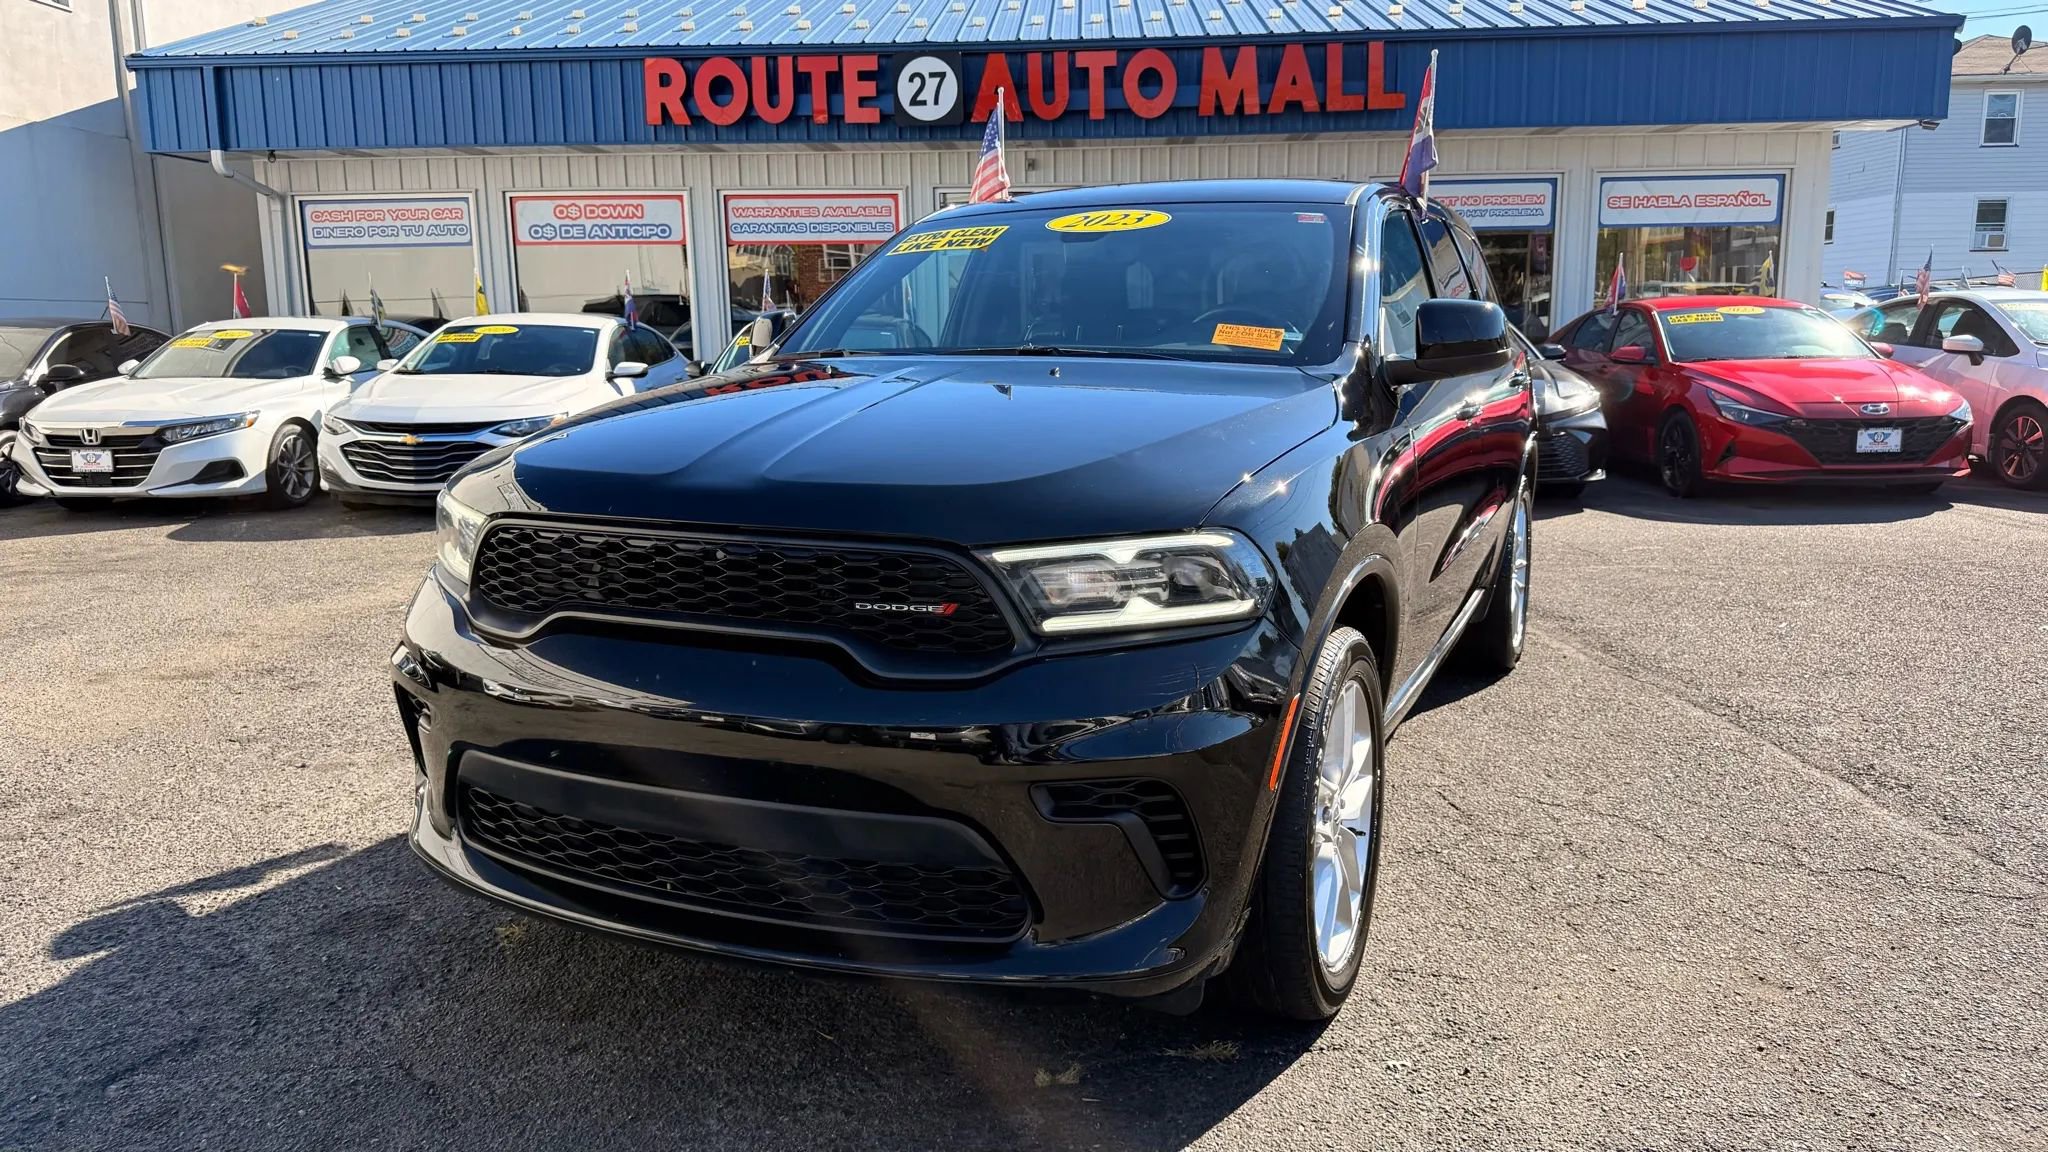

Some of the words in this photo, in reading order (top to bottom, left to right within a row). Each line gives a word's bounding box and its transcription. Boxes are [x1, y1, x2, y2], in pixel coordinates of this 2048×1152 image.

[643, 54, 881, 126] ROUTE
[907, 71, 947, 107] 27
[970, 48, 1178, 123] AUTO
[1198, 41, 1406, 116] MALL
[1461, 195, 1481, 206] NO
[1482, 194, 1545, 206] PROBLEM
[1607, 195, 1631, 208] SE
[1633, 194, 1691, 208] HABLA
[1694, 190, 1771, 207] ESPAÑOL
[311, 210, 353, 222] CASH
[355, 209, 385, 222] FOR
[387, 208, 429, 221] YOUR
[430, 208, 464, 220] CAR
[583, 204, 644, 219] DOWN
[732, 206, 820, 218] WARRANTIES
[822, 205, 892, 217] AVAILABLE
[1466, 209, 1488, 217] HAY
[1489, 208, 1544, 217] PROBLEMA
[730, 222, 807, 235] GARANTIAS
[809, 221, 894, 233] DISPONIBLES
[1061, 213, 1152, 228] 2023
[312, 226, 365, 239] DINERO
[367, 225, 399, 238] POR
[401, 225, 423, 236] TU
[426, 224, 468, 236] AUTO
[559, 224, 586, 239] DE
[588, 223, 672, 239] ANTICIPO
[908, 231, 950, 243] EXTRA
[951, 227, 1005, 238] CLEAN
[893, 240, 940, 252] LIKE
[940, 237, 995, 248] NEW
[856, 603, 944, 613] DODGE
